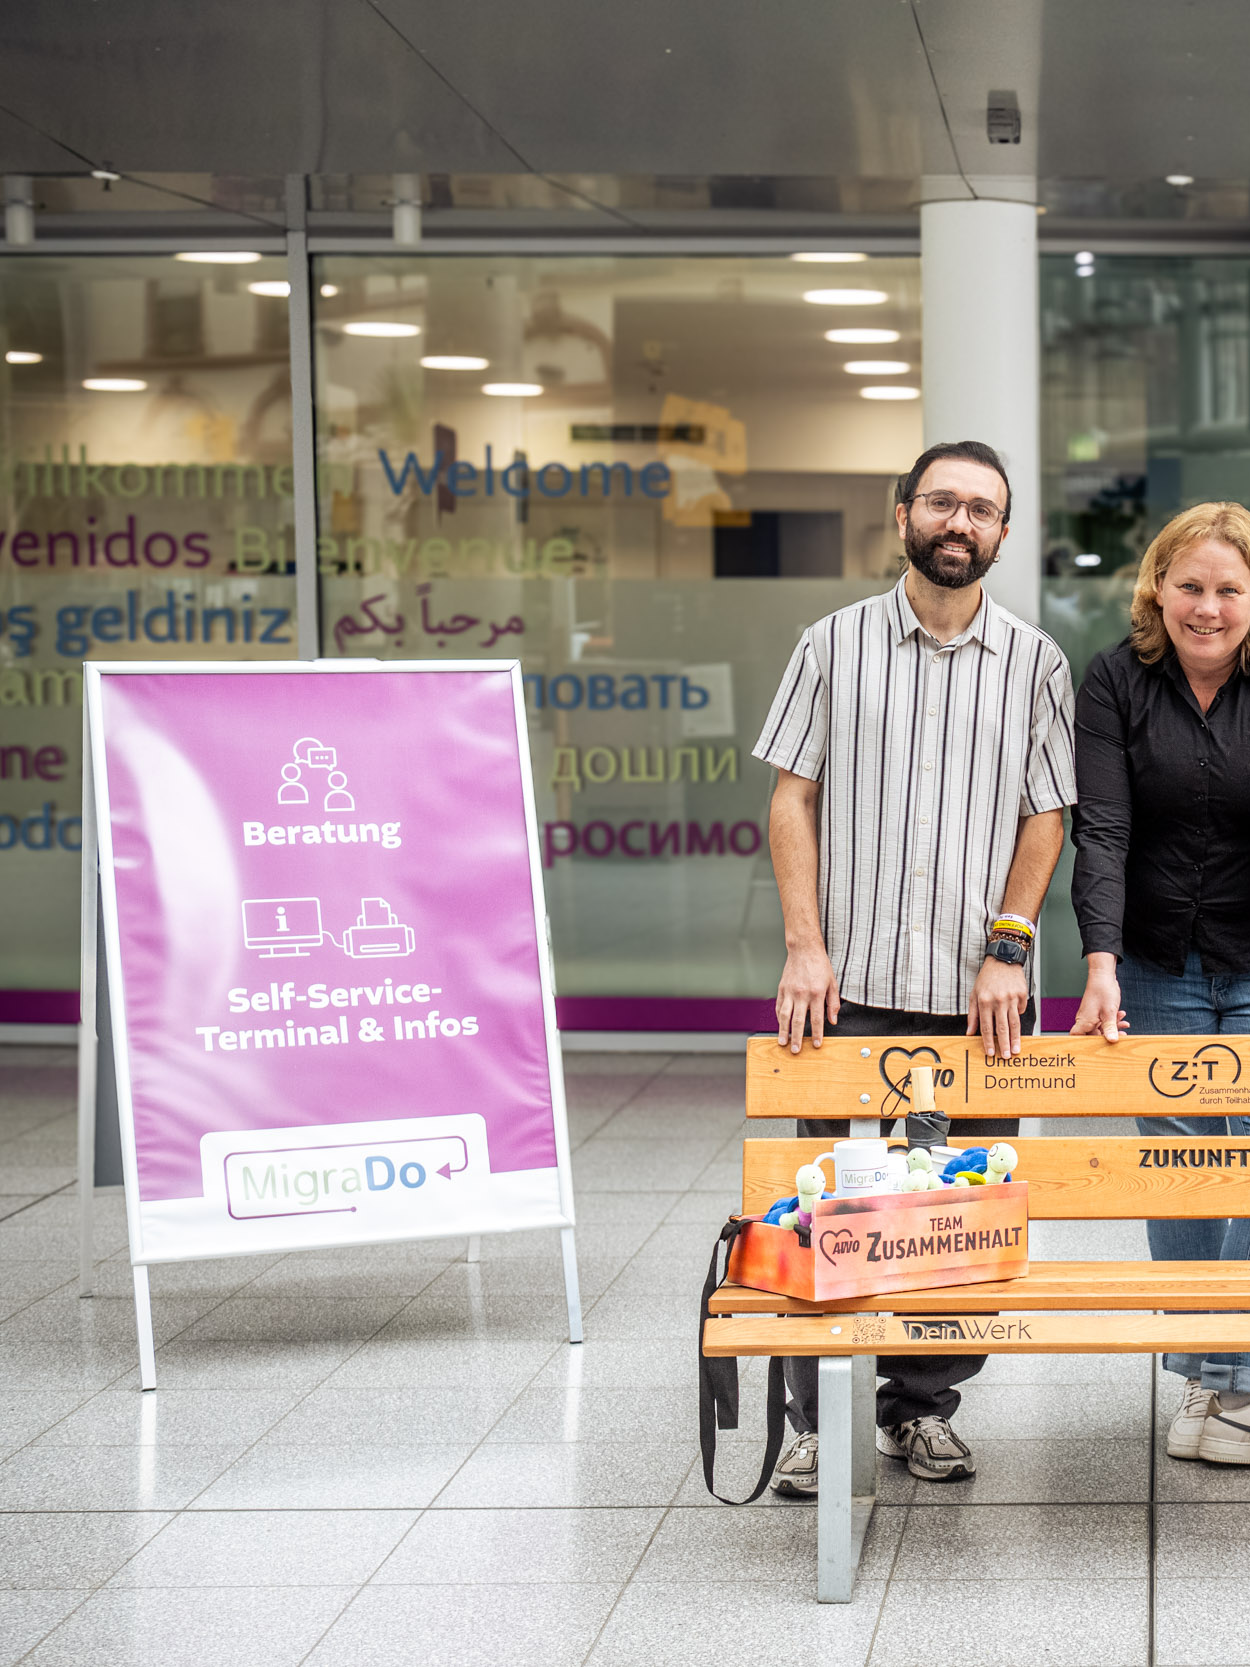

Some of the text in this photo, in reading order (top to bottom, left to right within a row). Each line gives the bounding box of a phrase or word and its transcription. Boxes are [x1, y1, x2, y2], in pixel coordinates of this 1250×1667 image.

[378, 443, 672, 498] Welcome
[55, 590, 292, 657] geldiniz
[242, 820, 402, 849] Beratung
[543, 820, 763, 869] росимо
[226, 978, 443, 1014] Self-Service-
[195, 1009, 480, 1052] Terminal & Infos
[984, 1073, 1077, 1090] Dortmund
[1199, 1096, 1223, 1105] durch
[1138, 1148, 1250, 1168] ZUKUNFT
[240, 1154, 428, 1206] MigraDo
[929, 1215, 963, 1232] TEAM
[832, 1226, 1023, 1263] AWO ZUSAMMENHALT
[908, 1319, 1033, 1340] DeinWerk
